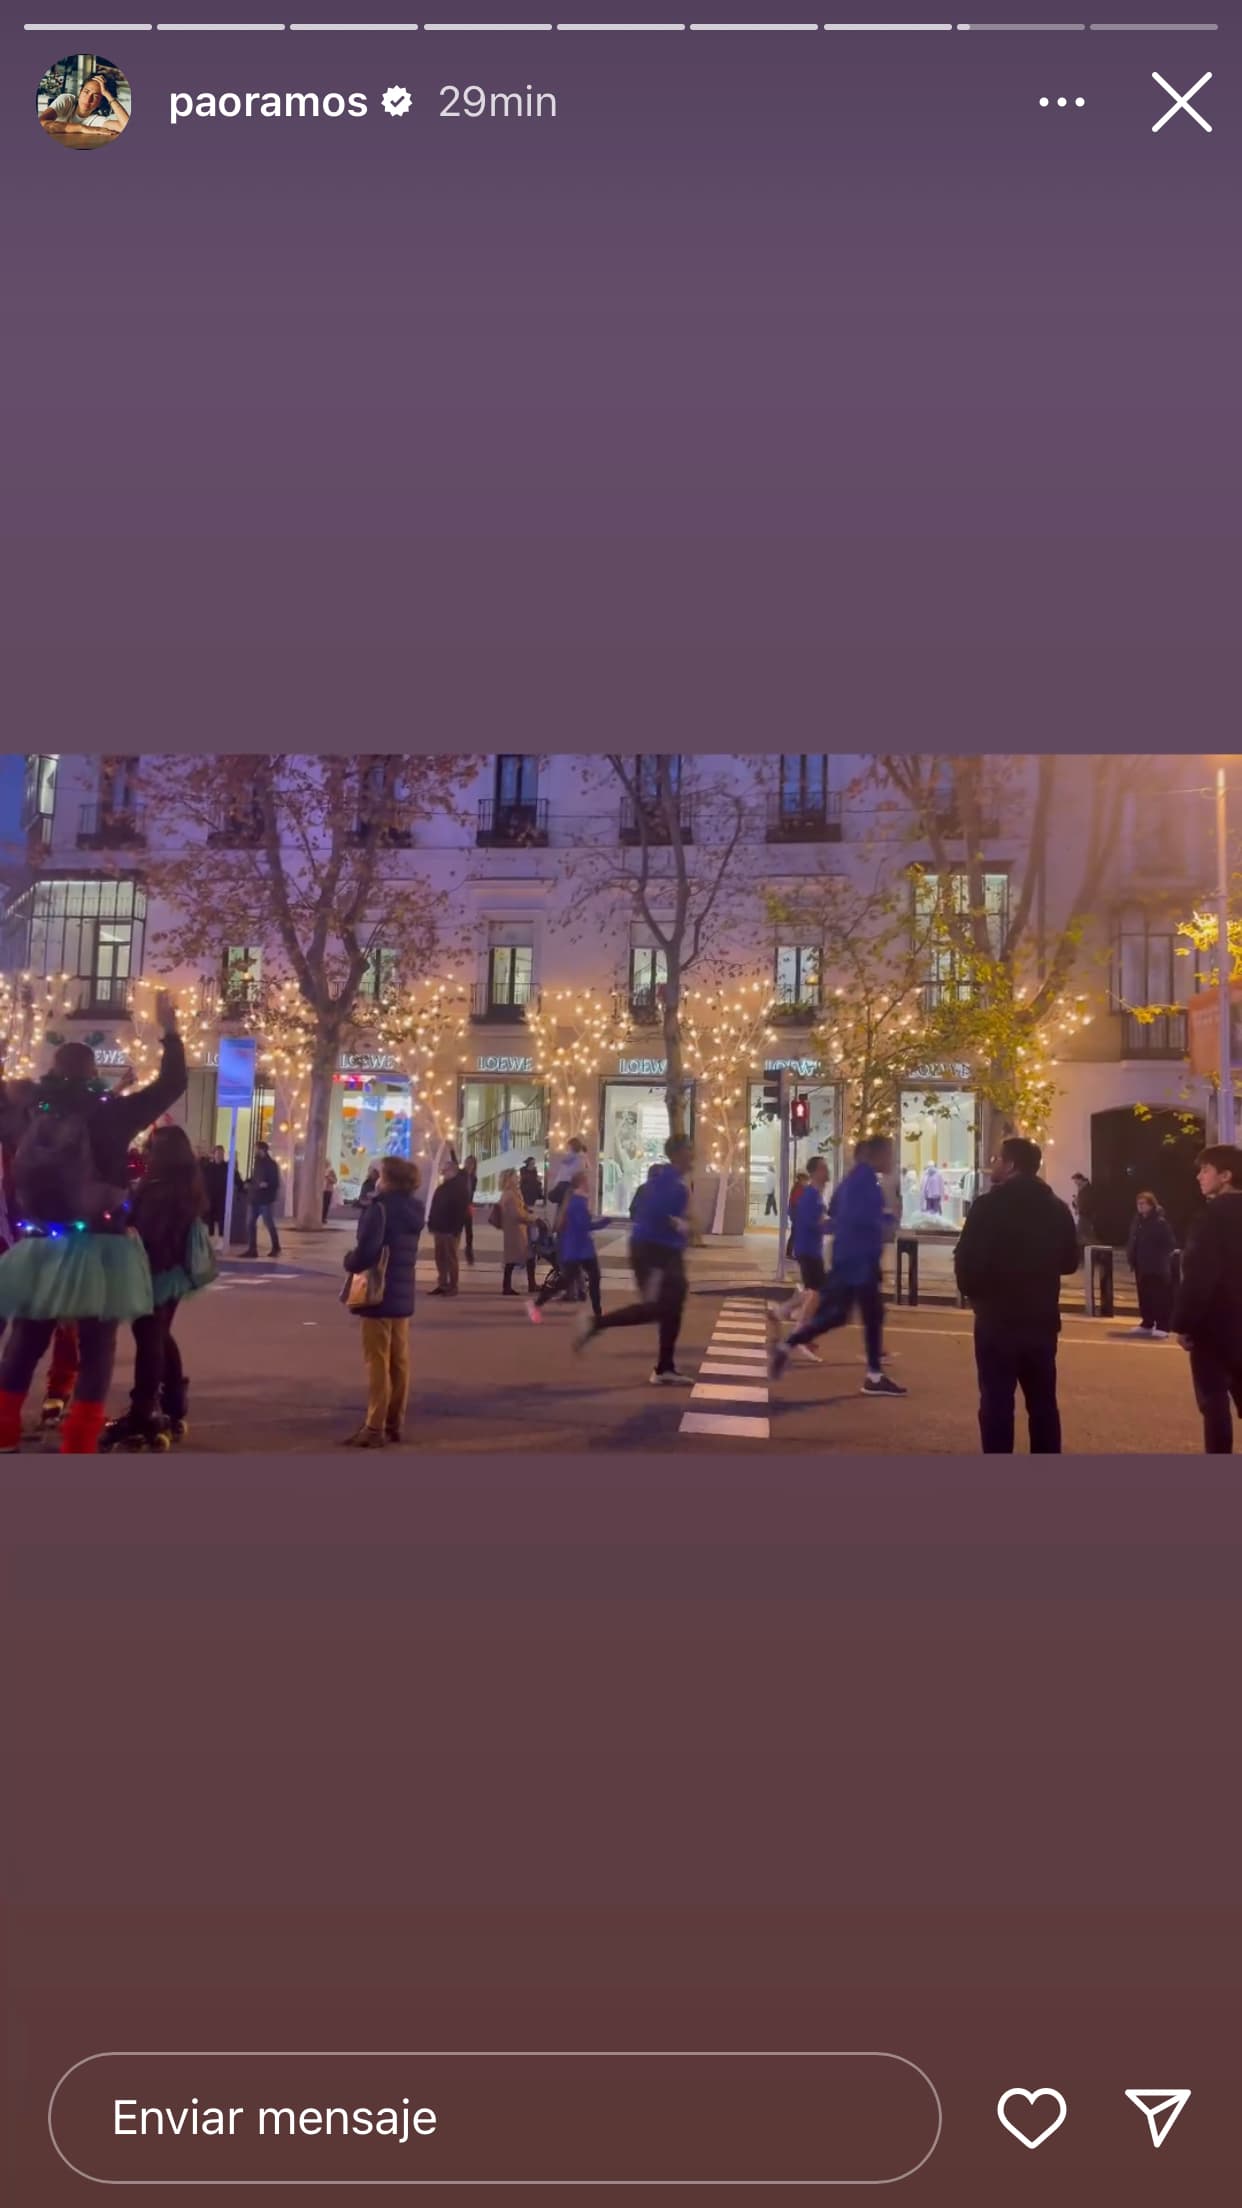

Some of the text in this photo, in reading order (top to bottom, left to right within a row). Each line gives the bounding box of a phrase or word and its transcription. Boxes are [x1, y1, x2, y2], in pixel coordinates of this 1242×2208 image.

[94, 1049, 126, 1065] EWE
[477, 1056, 534, 1072] LOEWE
[618, 1058, 668, 1075] LOEW
